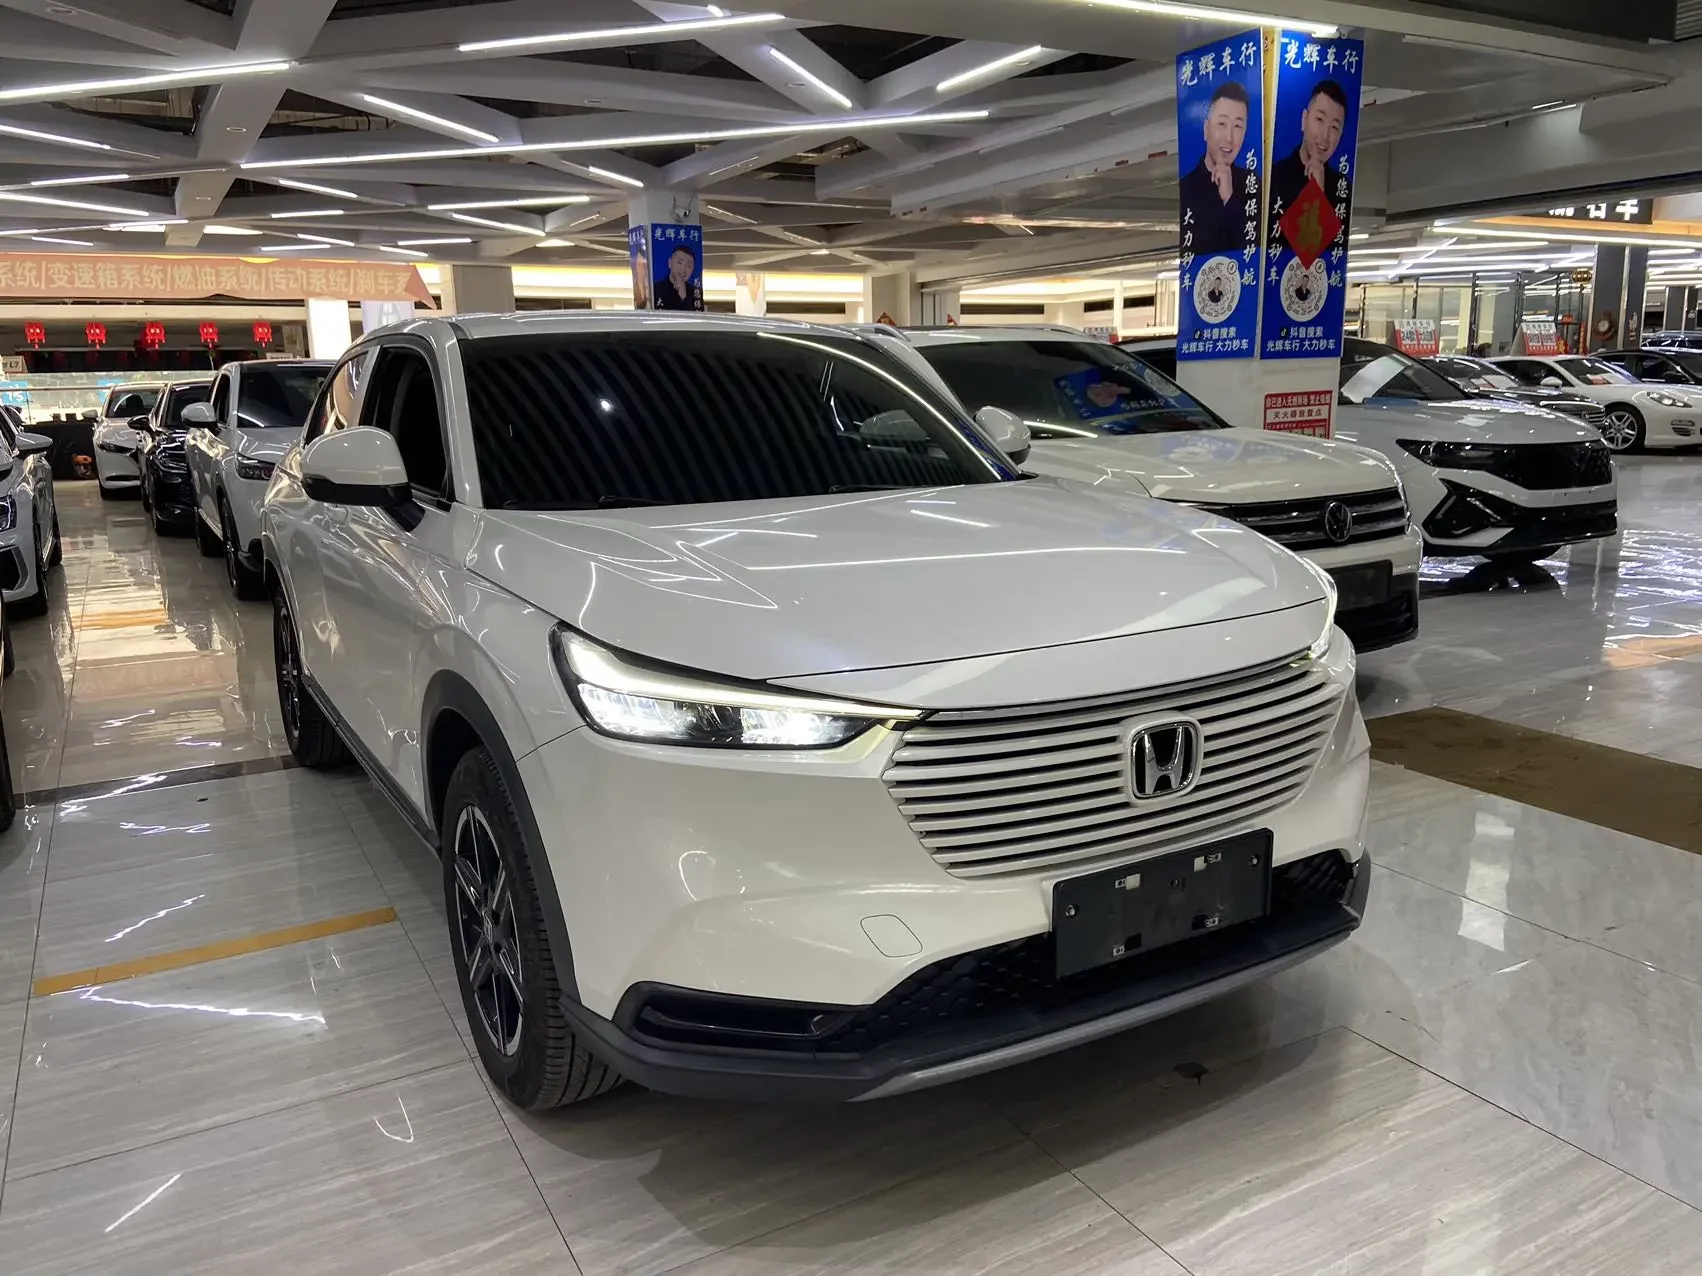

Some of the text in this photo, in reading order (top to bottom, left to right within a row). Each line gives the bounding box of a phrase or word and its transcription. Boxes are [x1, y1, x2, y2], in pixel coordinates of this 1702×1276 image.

[1181, 42, 1256, 86] 光辉车行
[1284, 40, 1359, 74] 光辉车行
[1241, 149, 1258, 286] 为您保驾护航
